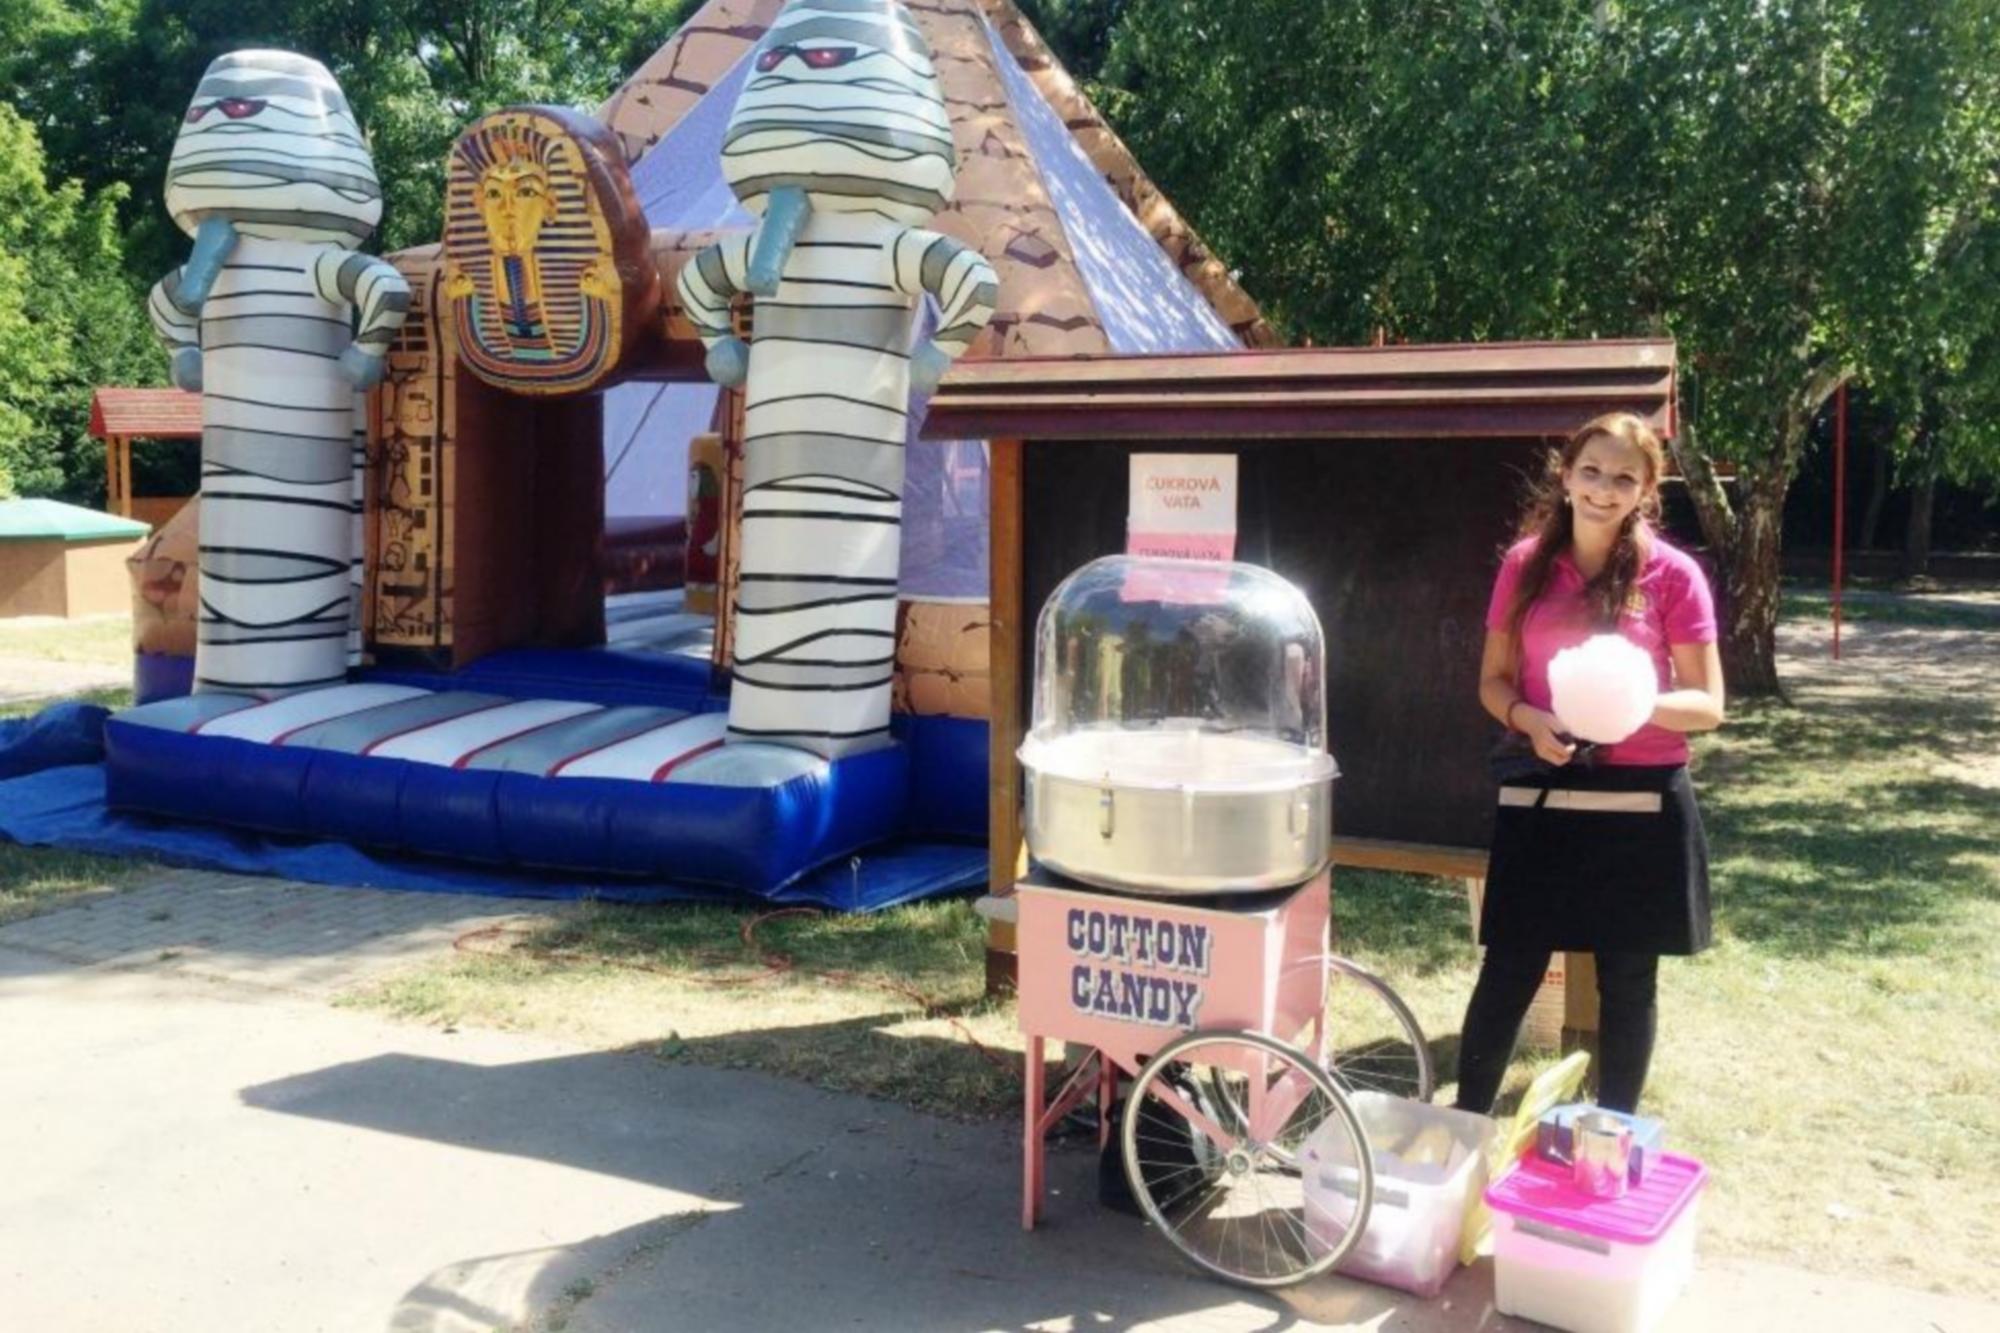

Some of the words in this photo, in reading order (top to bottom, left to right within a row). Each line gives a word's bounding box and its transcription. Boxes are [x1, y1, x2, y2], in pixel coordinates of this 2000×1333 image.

[1162, 494, 1202, 509] VATA
[1067, 907, 1208, 970] COTTON
[1071, 964, 1198, 1027] CANDY
